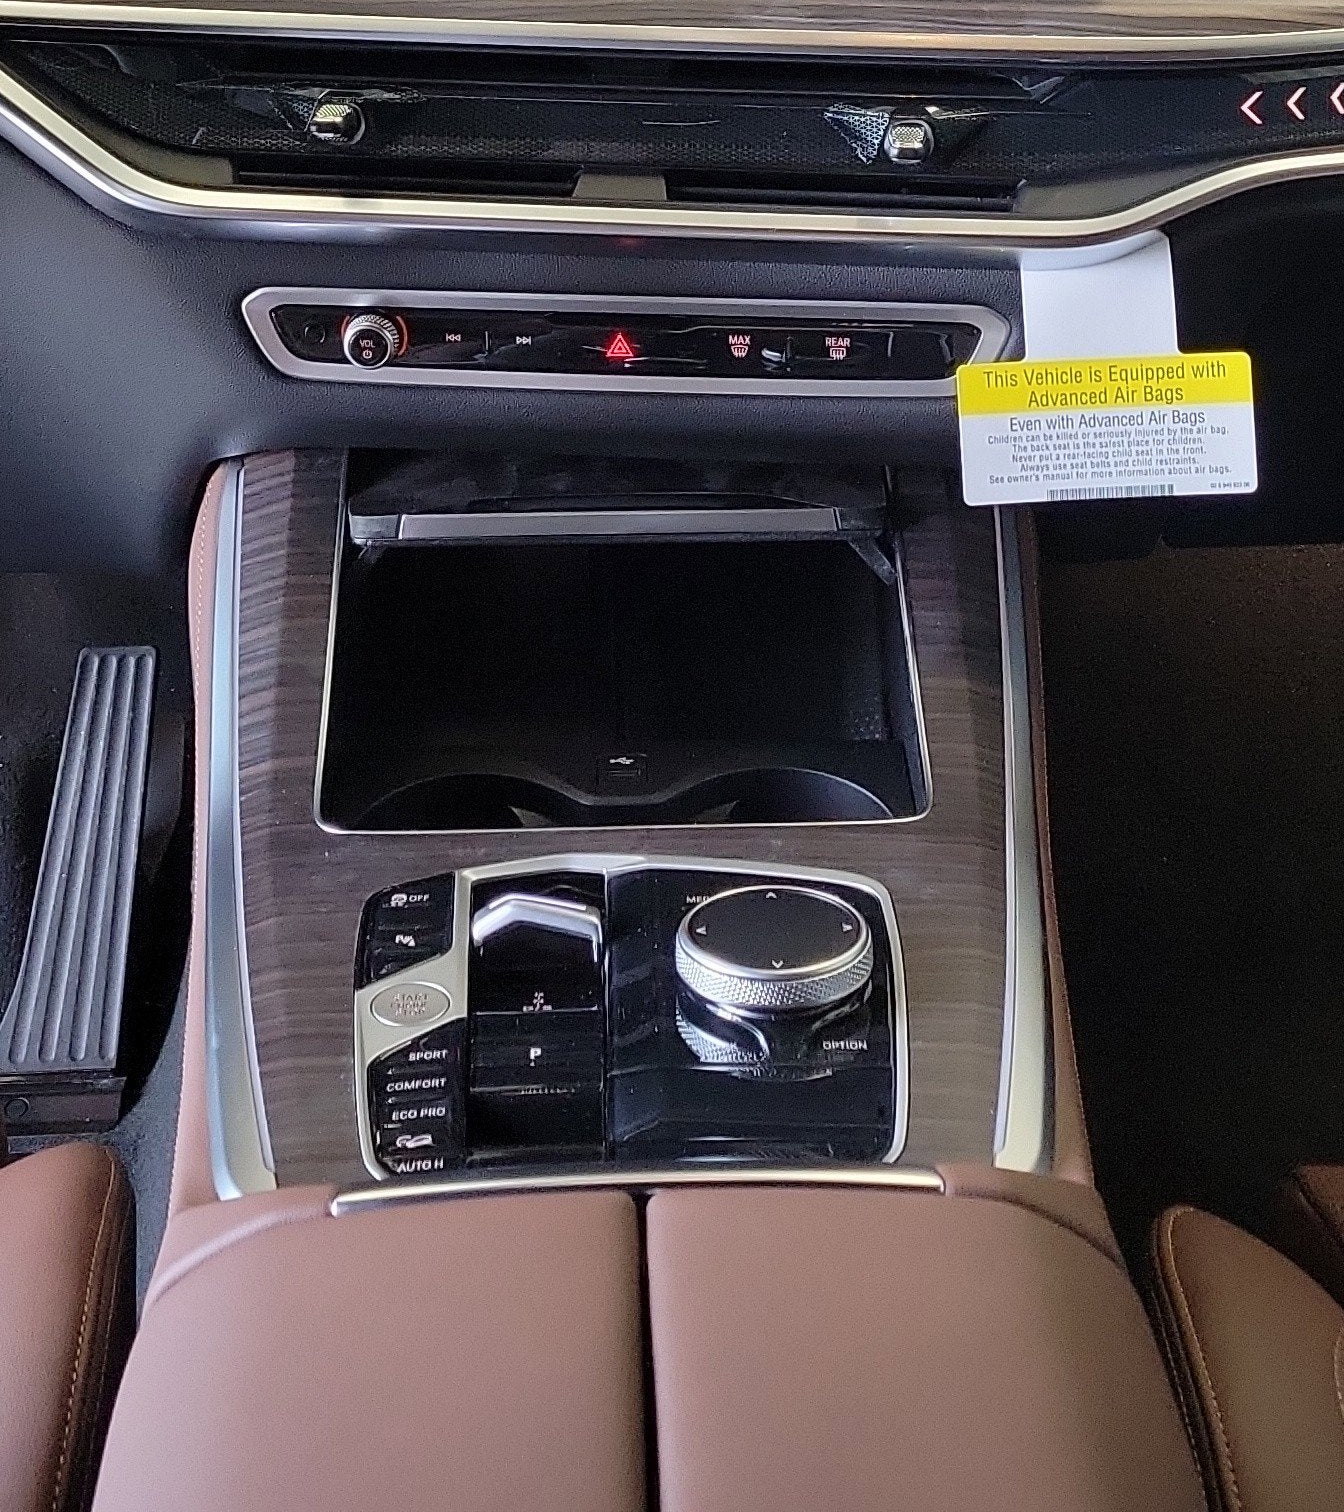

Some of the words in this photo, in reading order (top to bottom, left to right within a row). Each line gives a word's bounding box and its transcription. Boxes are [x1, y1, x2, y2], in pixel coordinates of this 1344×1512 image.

[359, 339, 376, 348] VOL
[728, 334, 751, 345] MAX
[825, 336, 851, 347] REAR
[983, 370, 1018, 389] This
[1023, 366, 1083, 386] Vehicle
[1089, 365, 1103, 383] is
[1108, 362, 1185, 384] Equipped
[1191, 360, 1226, 378] with
[1028, 386, 1108, 408] Advanced
[1114, 386, 1137, 404] Air
[1143, 385, 1184, 405] Bags
[1009, 416, 1042, 432] Even
[1046, 414, 1074, 430] with
[1078, 411, 1144, 429] Advanced
[1148, 410, 1168, 426] Air
[1172, 409, 1206, 426] Bags
[988, 434, 1023, 445] Children
[1025, 434, 1041, 443] can
[1043, 433, 1054, 441] be
[1056, 431, 1079, 441] killed
[1081, 431, 1090, 440] or
[1093, 428, 1132, 439] seriously
[1134, 427, 1165, 438] injured
[1167, 427, 1177, 437] by
[1180, 426, 1194, 435] the
[1196, 425, 1207, 434] air
[1210, 425, 1229, 435] bag.
[1012, 444, 1028, 453] The
[1030, 443, 1050, 452] back
[1053, 442, 1070, 451] seat
[1072, 441, 1080, 450] is
[1083, 441, 1097, 449] the
[1099, 439, 1125, 448] safest
[1127, 438, 1150, 448] place
[1152, 437, 1165, 446] for
[1167, 436, 1205, 446] children.
[1012, 454, 1036, 463] Never
[1039, 453, 1053, 463] put
[1055, 453, 1060, 461] a
[1063, 450, 1109, 461] rear-facing
[1111, 449, 1133, 458] child
[1135, 448, 1153, 457] seat
[1155, 447, 1164, 456] in
[1166, 446, 1180, 455] the
[1182, 445, 1207, 455] front.
[1020, 464, 1050, 473] Always
[1052, 462, 1067, 471] use
[1070, 461, 1088, 469] seat
[1090, 460, 1111, 469] belts
[1113, 459, 1129, 468] and
[1131, 458, 1153, 467] child
[1155, 456, 1200, 466] restraints.
[989, 475, 1005, 484] See
[1007, 473, 1040, 484] owner's
[1043, 471, 1073, 481] manual
[1076, 470, 1088, 479] for
[1091, 470, 1113, 479] more
[1115, 467, 1165, 478] information
[1167, 466, 1192, 476] about
[1194, 465, 1206, 474] air
[1208, 465, 1232, 475] bags.
[408, 894, 430, 902] OFF
[822, 1039, 868, 1050] OPTION
[408, 1049, 448, 1061] SPORT
[529, 1047, 542, 1060] P
[386, 1077, 447, 1092] COMFORT
[391, 1109, 417, 1121] ECO
[419, 1107, 446, 1118] PRO
[396, 1159, 432, 1174] AUTO
[434, 1156, 444, 1169] H
